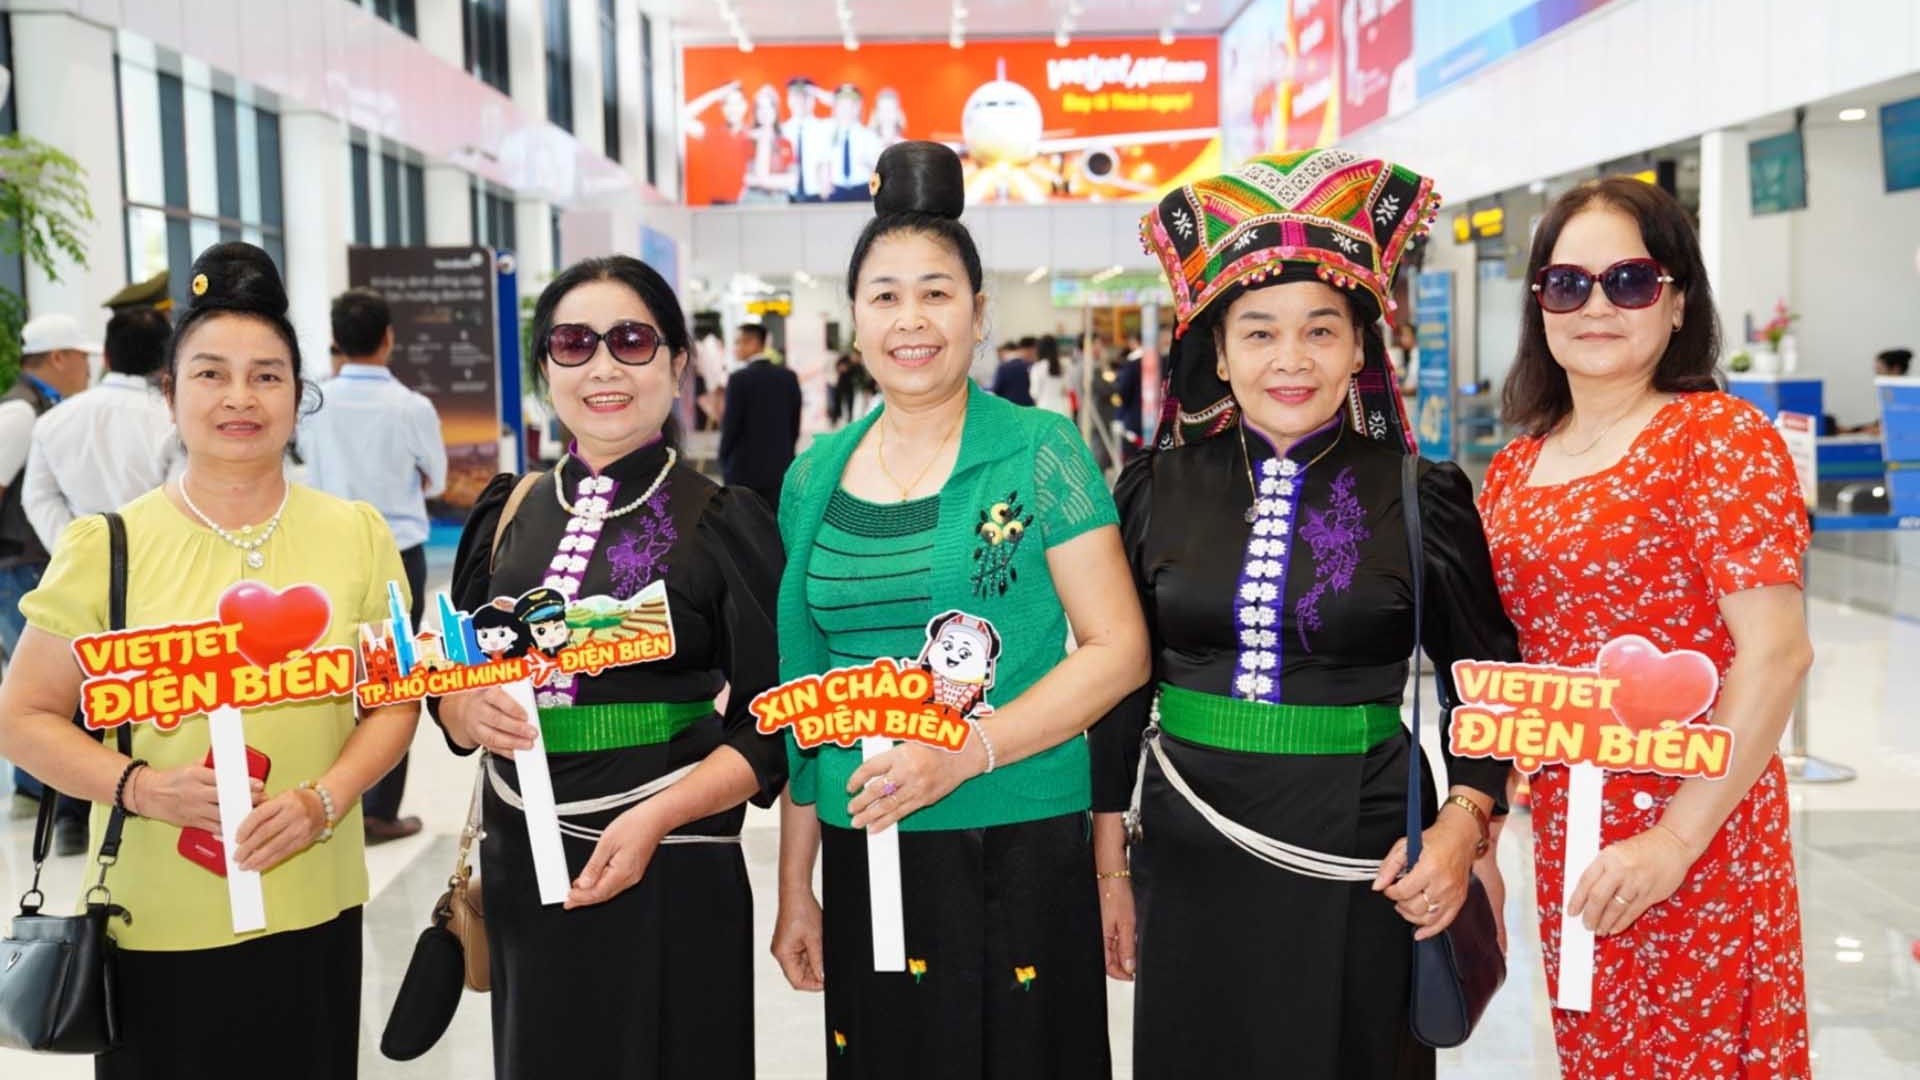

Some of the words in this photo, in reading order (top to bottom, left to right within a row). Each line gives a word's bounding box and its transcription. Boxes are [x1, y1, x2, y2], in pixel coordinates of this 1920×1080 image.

[80, 622, 243, 672] VIETJET
[360, 683, 392, 704] TP.
[429, 665, 463, 692] CHÍ
[467, 660, 522, 687] MINH
[560, 643, 614, 672] ĐIỆN
[618, 634, 670, 661] BIÊN
[89, 666, 218, 724] ĐIỆN
[231, 649, 349, 703] BIÊN
[757, 684, 818, 727] XIN
[825, 663, 928, 700] CHÀO
[1460, 668, 1621, 711] VIETJET
[799, 705, 876, 742] ĐIỆN
[885, 709, 965, 746] BIÊN
[1458, 708, 1584, 767] ĐIỆN
[1597, 720, 1725, 772] BIÊN
